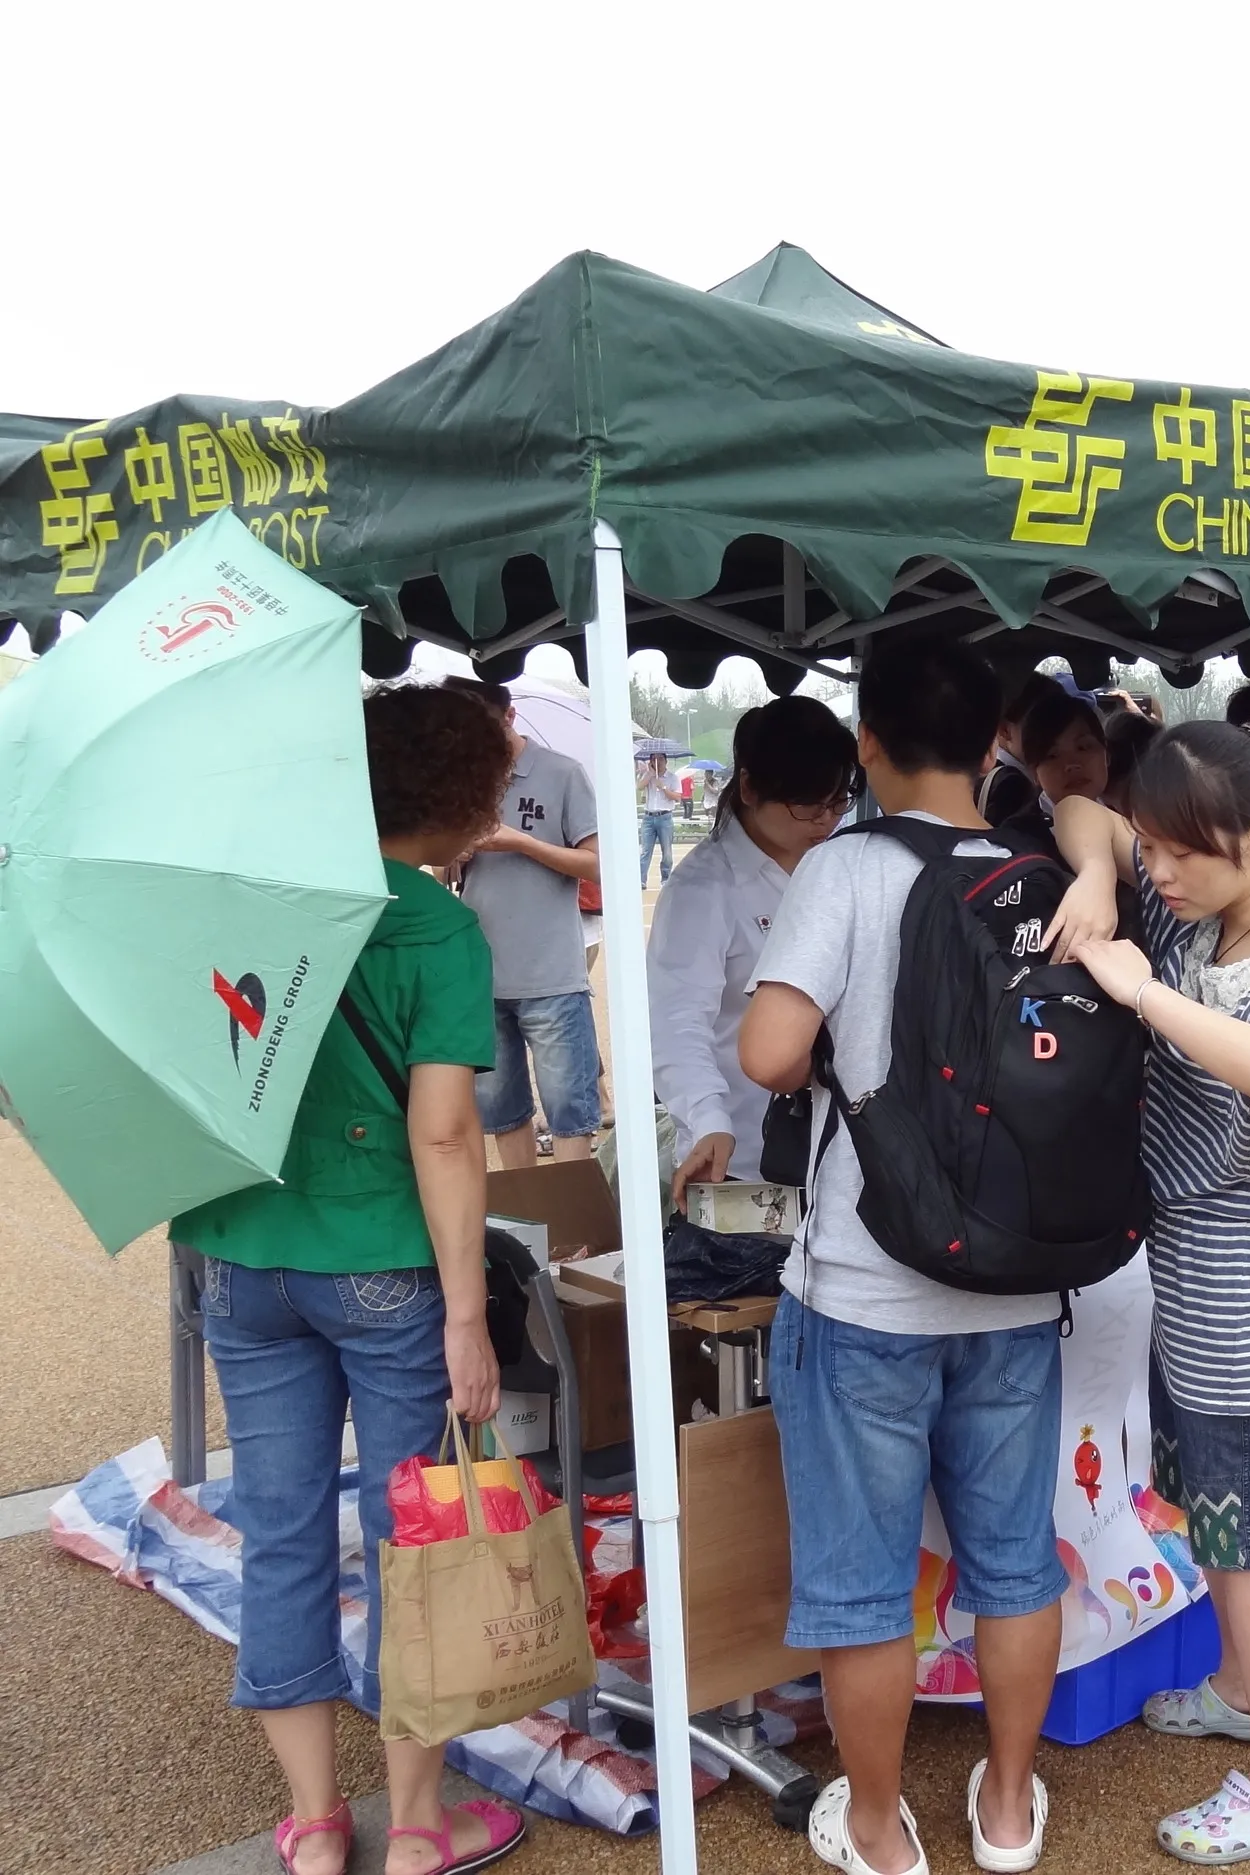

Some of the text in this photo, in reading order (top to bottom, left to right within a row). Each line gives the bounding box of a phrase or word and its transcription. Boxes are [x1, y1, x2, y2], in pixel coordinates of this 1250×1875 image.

[124, 407, 328, 523] 中国邮政
[249, 955, 311, 1113] ZHONGDENG GROUP
[483, 1601, 565, 1638] XI'AN HOTEL
